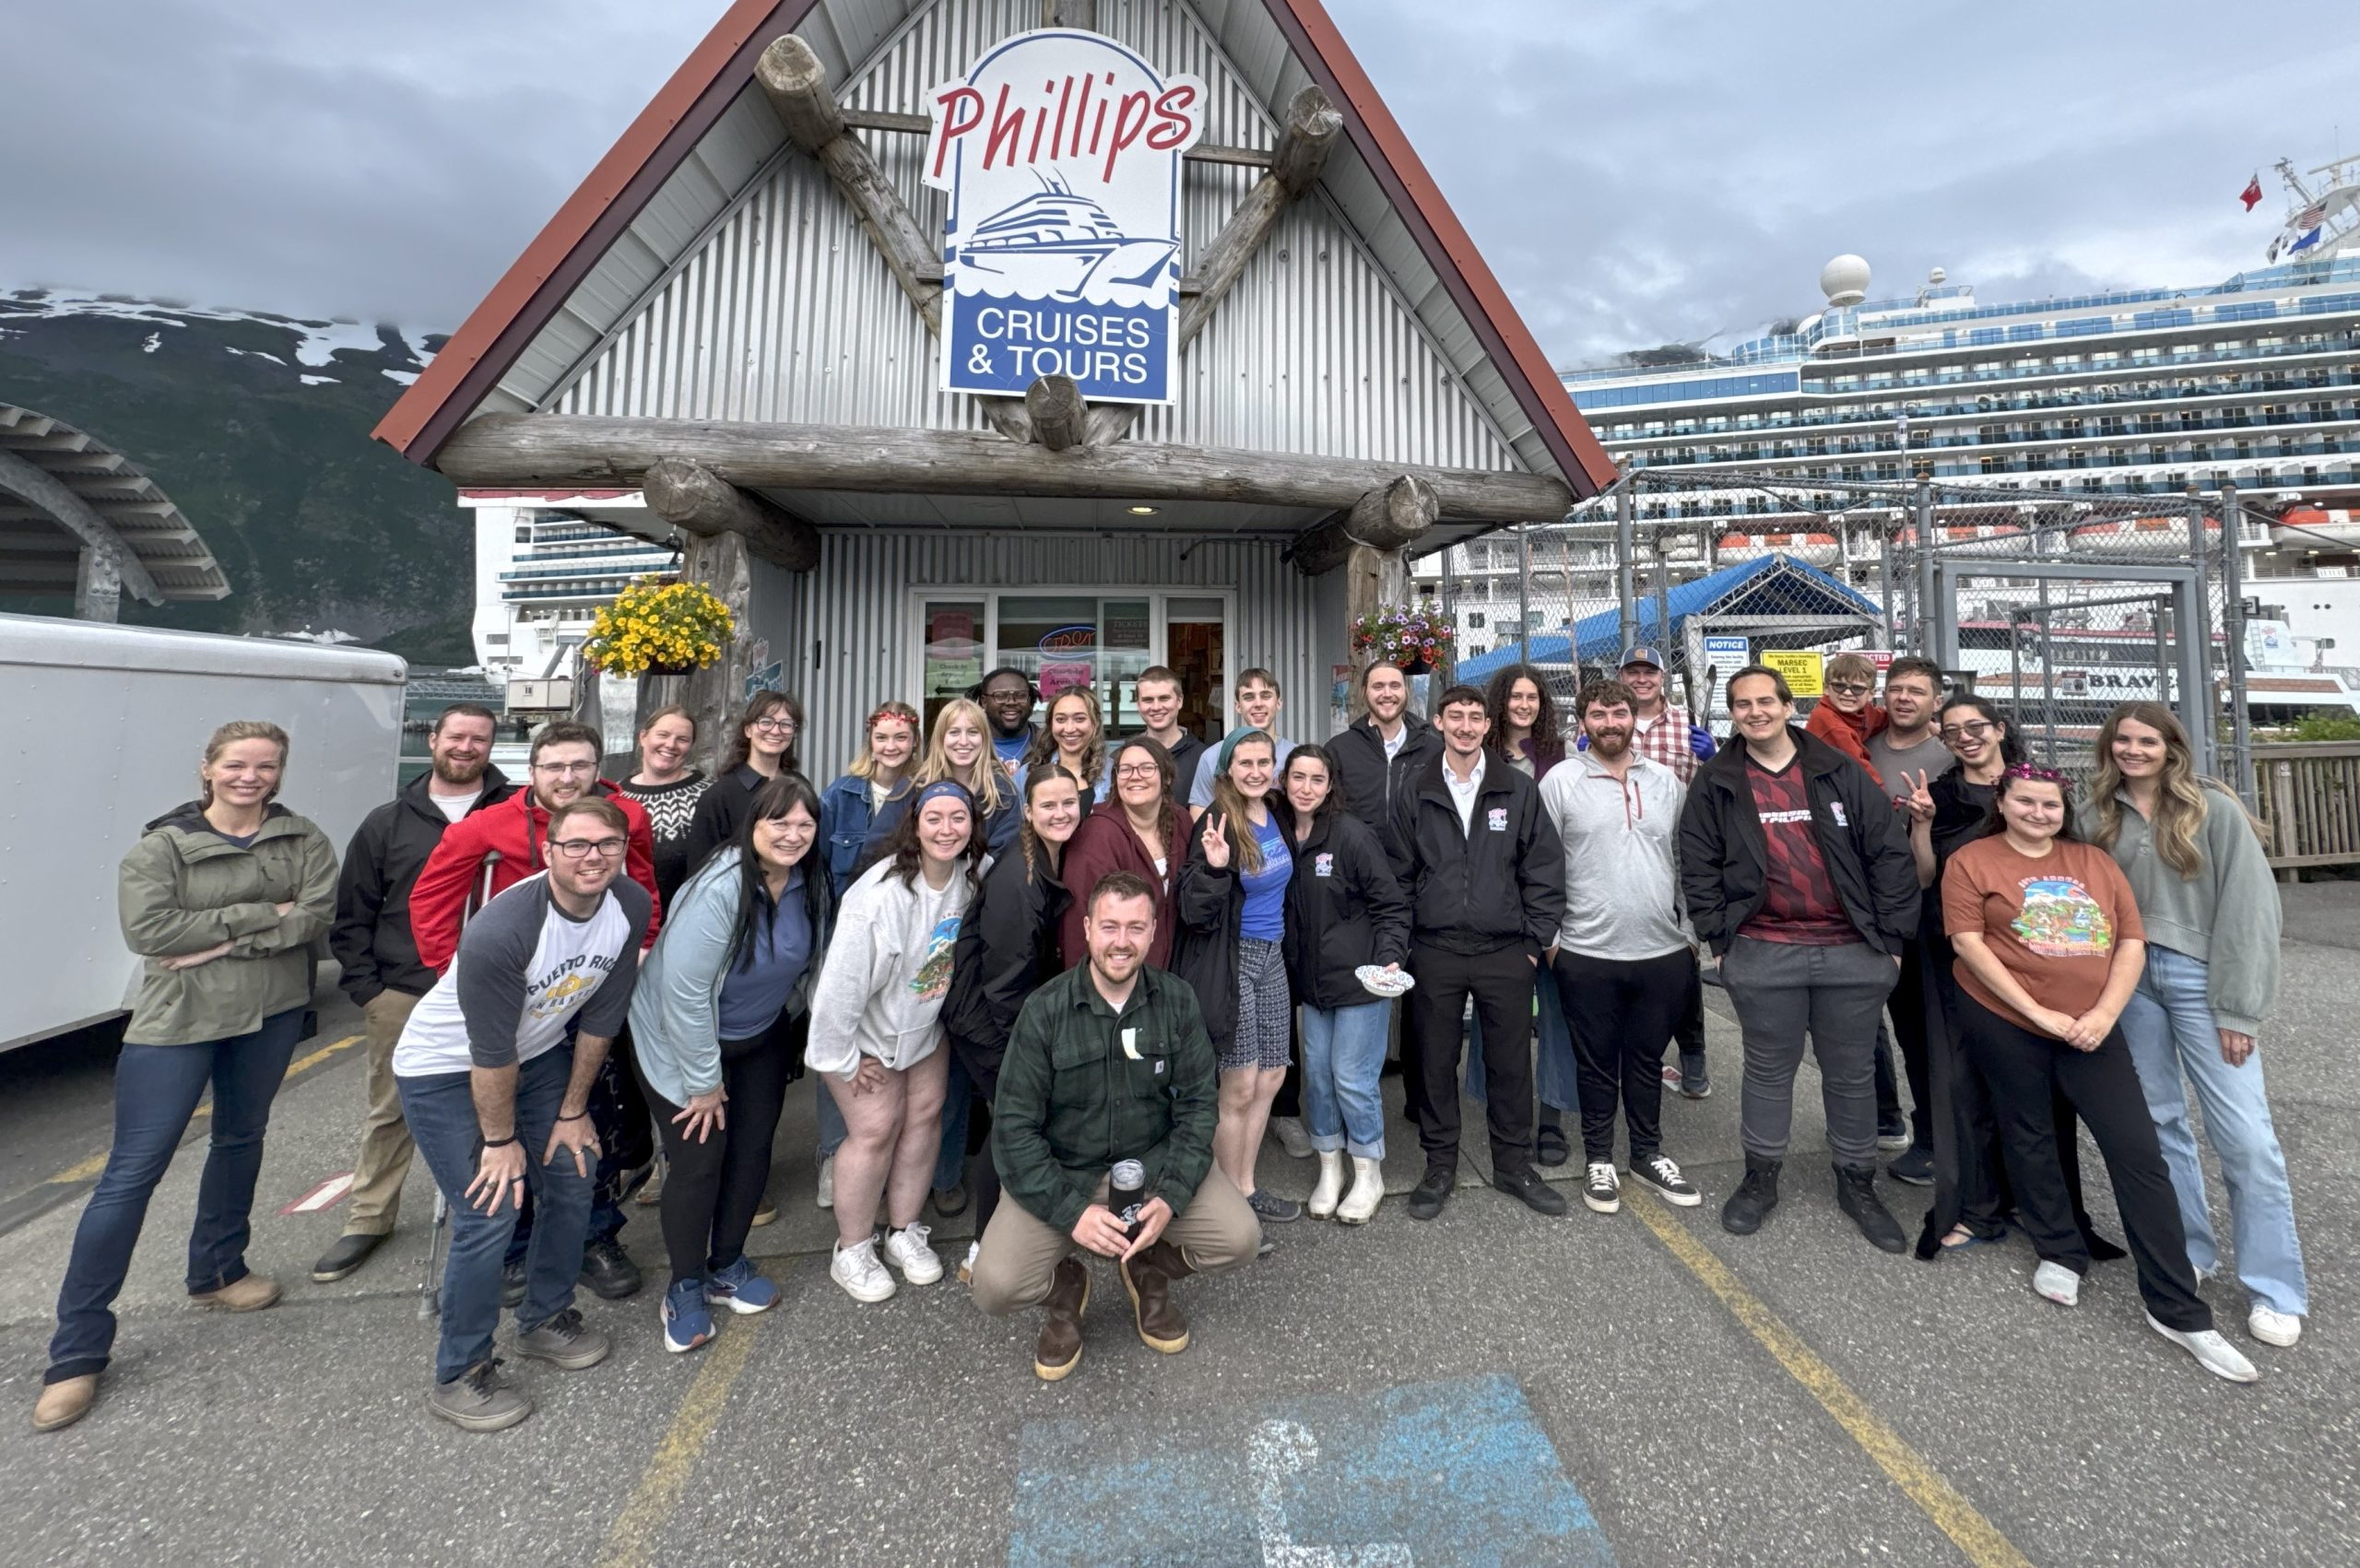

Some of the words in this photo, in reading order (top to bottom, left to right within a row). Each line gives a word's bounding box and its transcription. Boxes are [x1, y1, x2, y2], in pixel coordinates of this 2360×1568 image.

[933, 72, 1196, 183] Phillips
[976, 307, 1150, 348] CRUISES
[967, 343, 994, 374] &
[1007, 345, 1148, 384] TOURS
[1708, 641, 1744, 649] NOTICE
